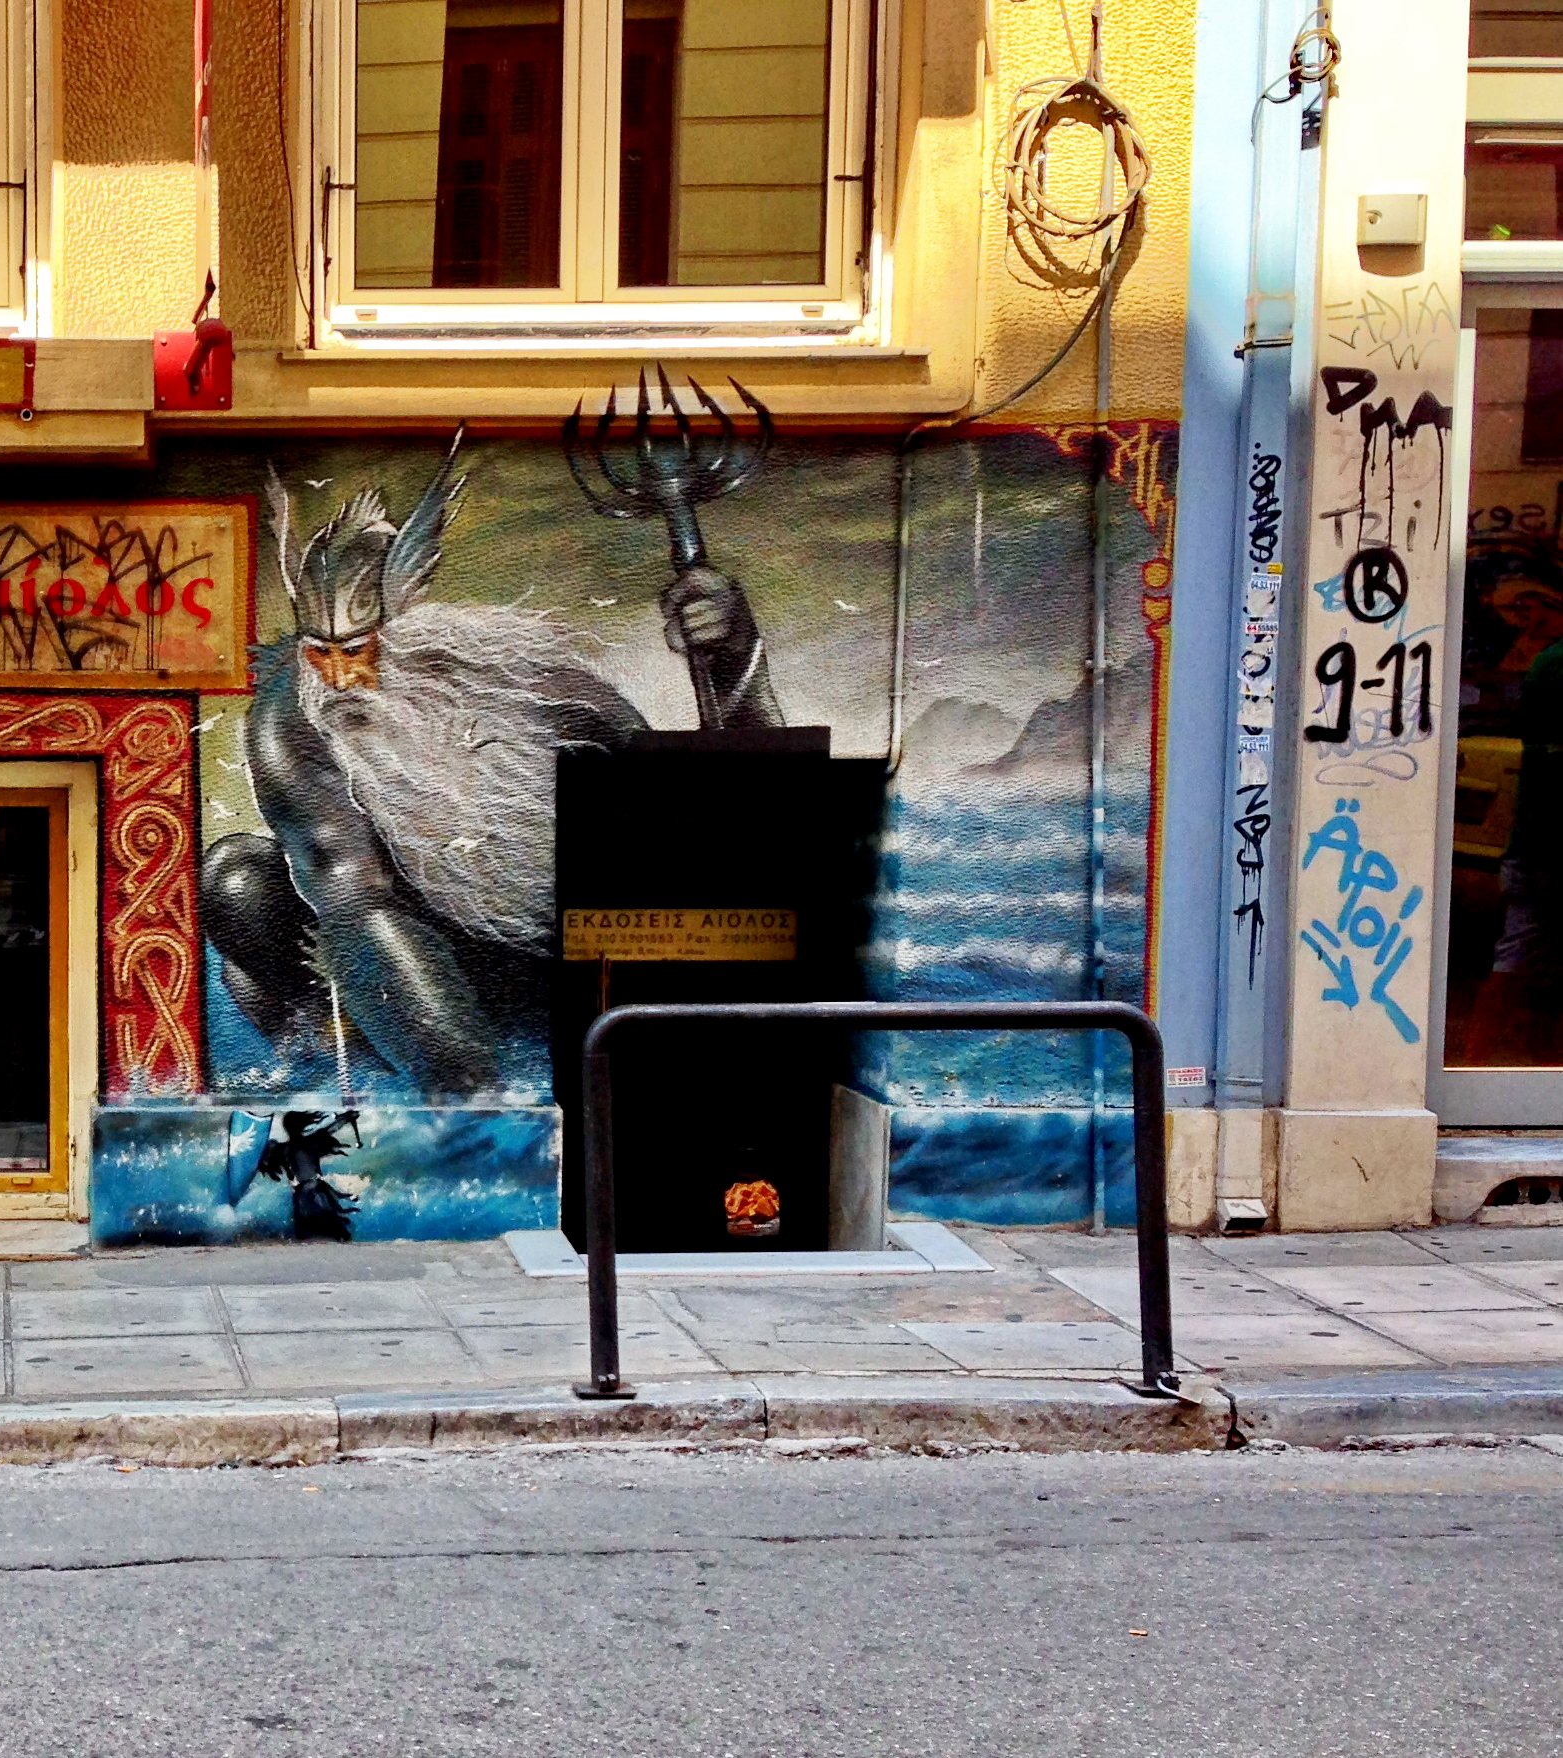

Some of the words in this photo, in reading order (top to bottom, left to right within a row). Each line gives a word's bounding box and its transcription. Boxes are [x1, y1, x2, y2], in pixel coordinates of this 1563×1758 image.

[1303, 641, 1432, 743] 9-11
[567, 912, 686, 928] ΕΚΔΟΣΕΙΣ
[701, 912, 791, 928] ΑΙΟΛΟΣ
